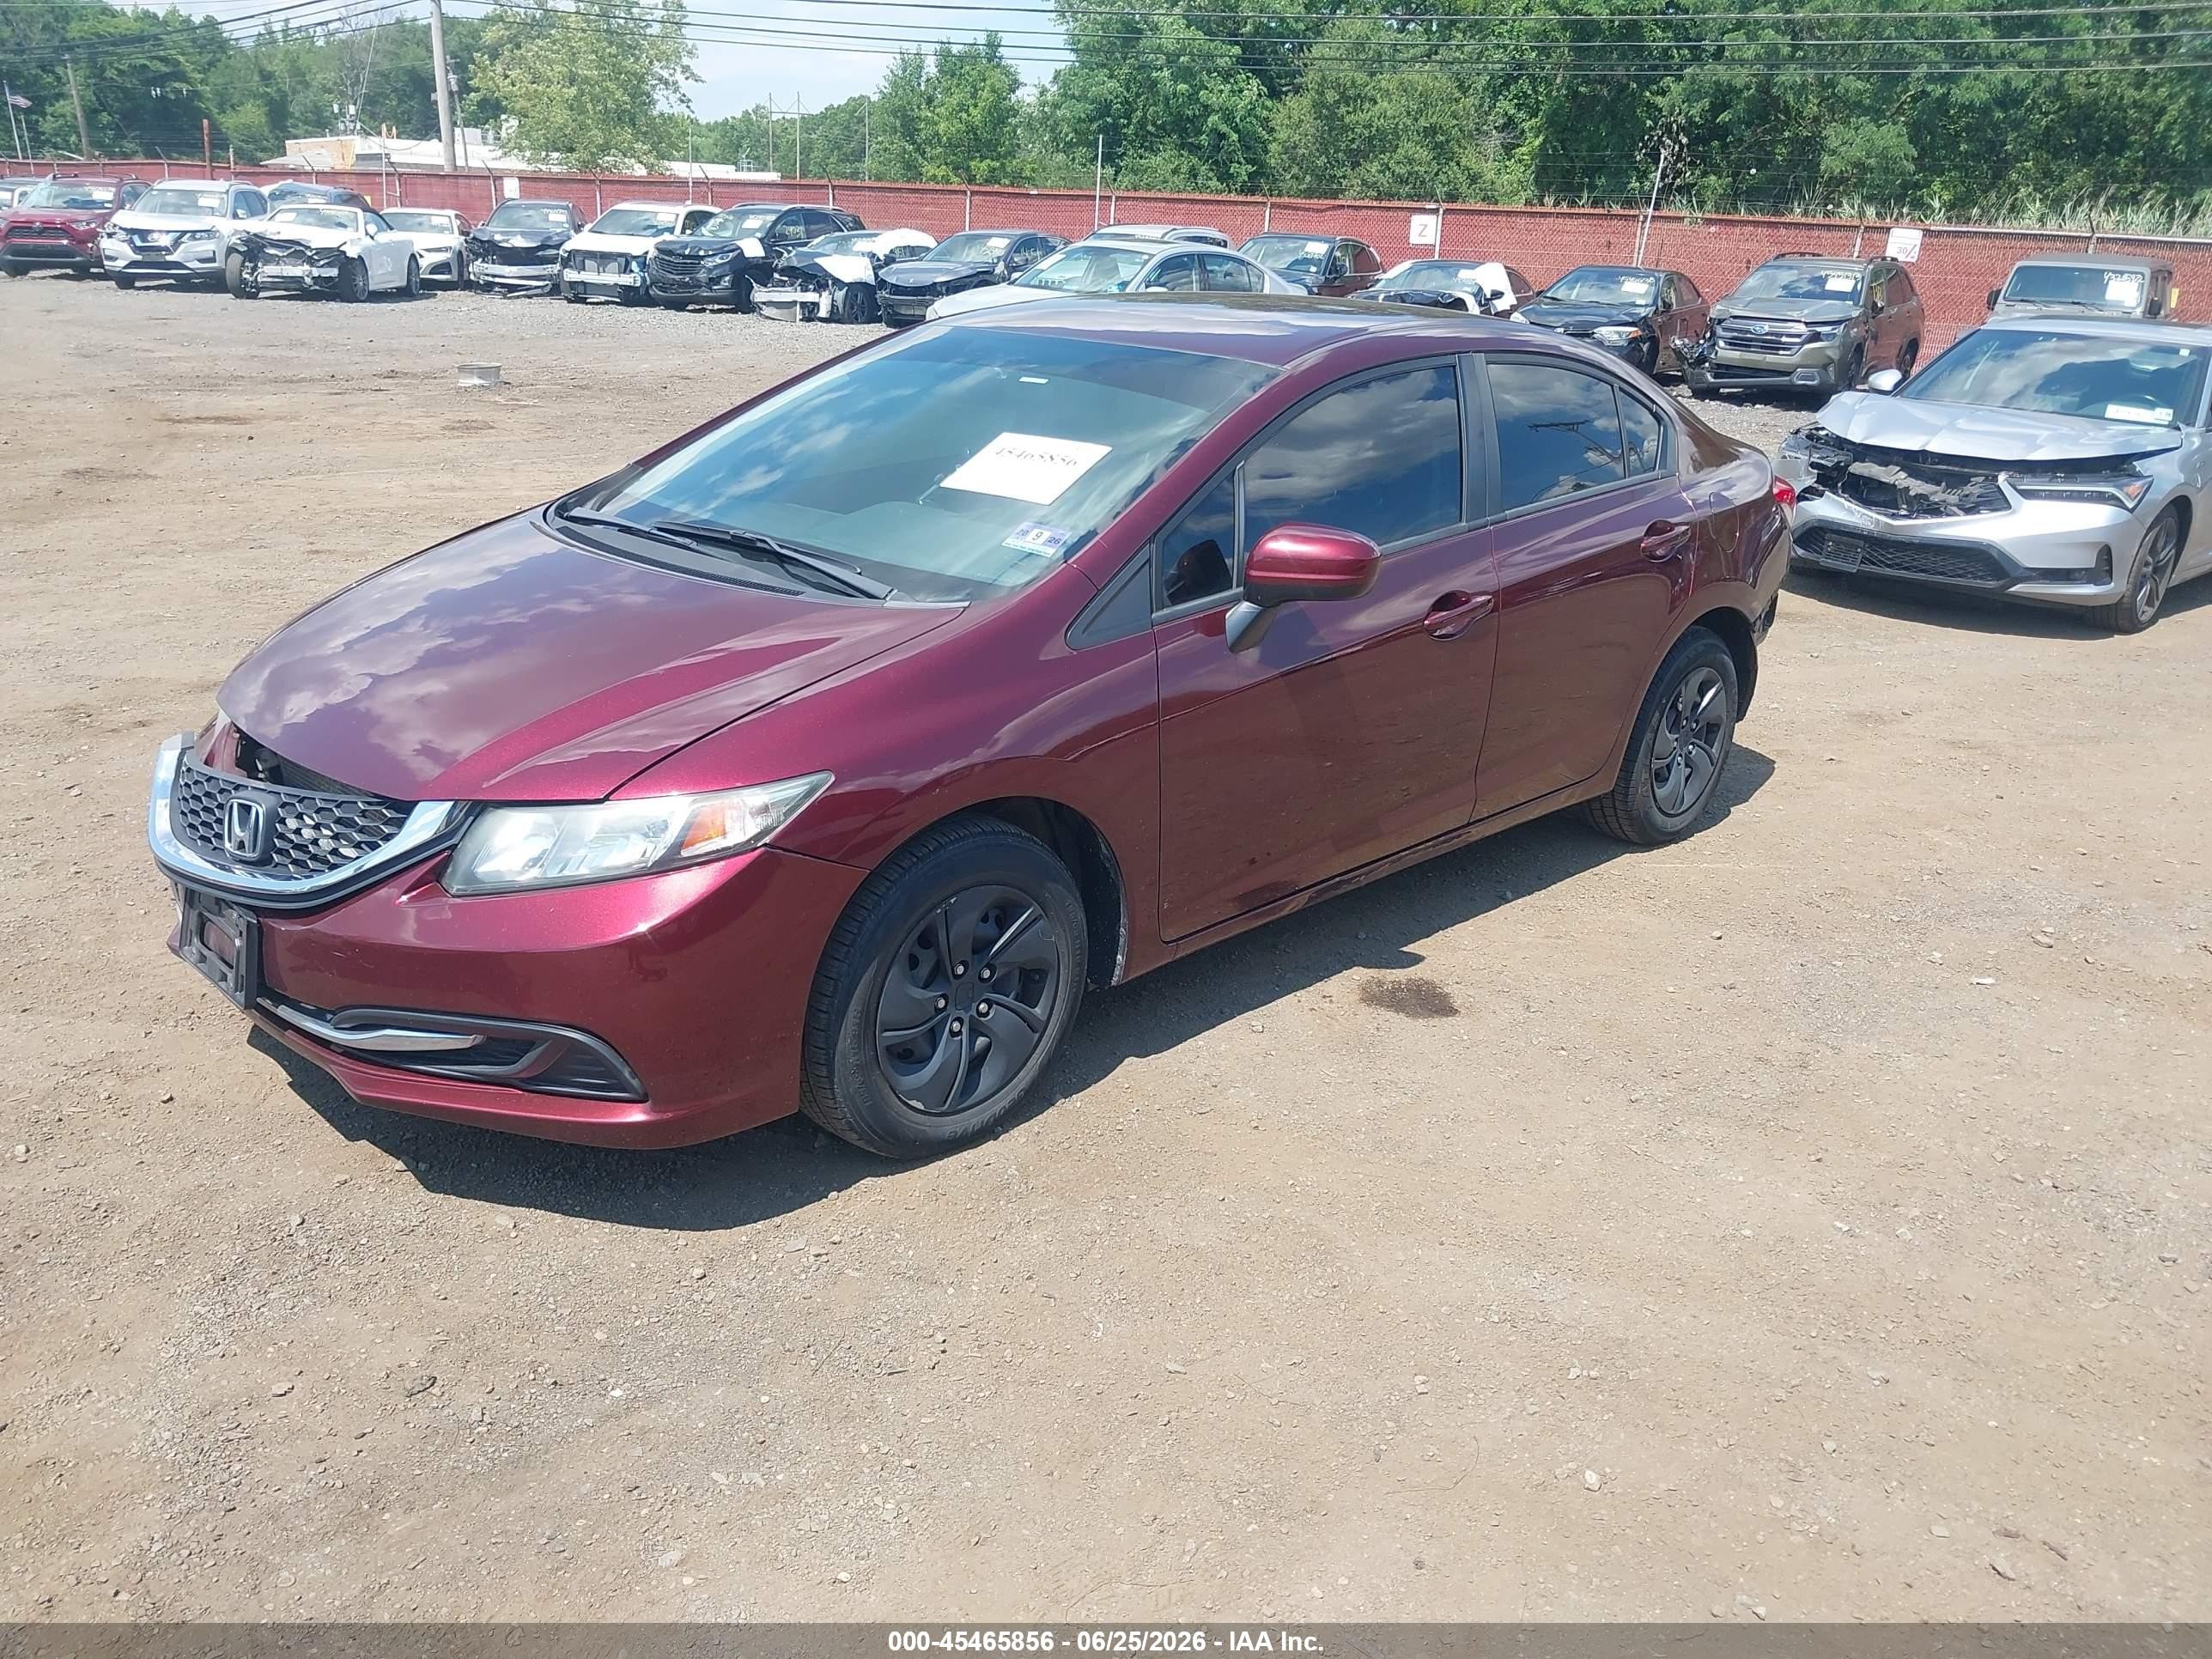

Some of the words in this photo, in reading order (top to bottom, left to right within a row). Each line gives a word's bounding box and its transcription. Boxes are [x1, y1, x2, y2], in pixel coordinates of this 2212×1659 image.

[1418, 223, 1429, 238] Z
[1031, 530, 1044, 541] 9
[1047, 536, 1062, 545] 26
